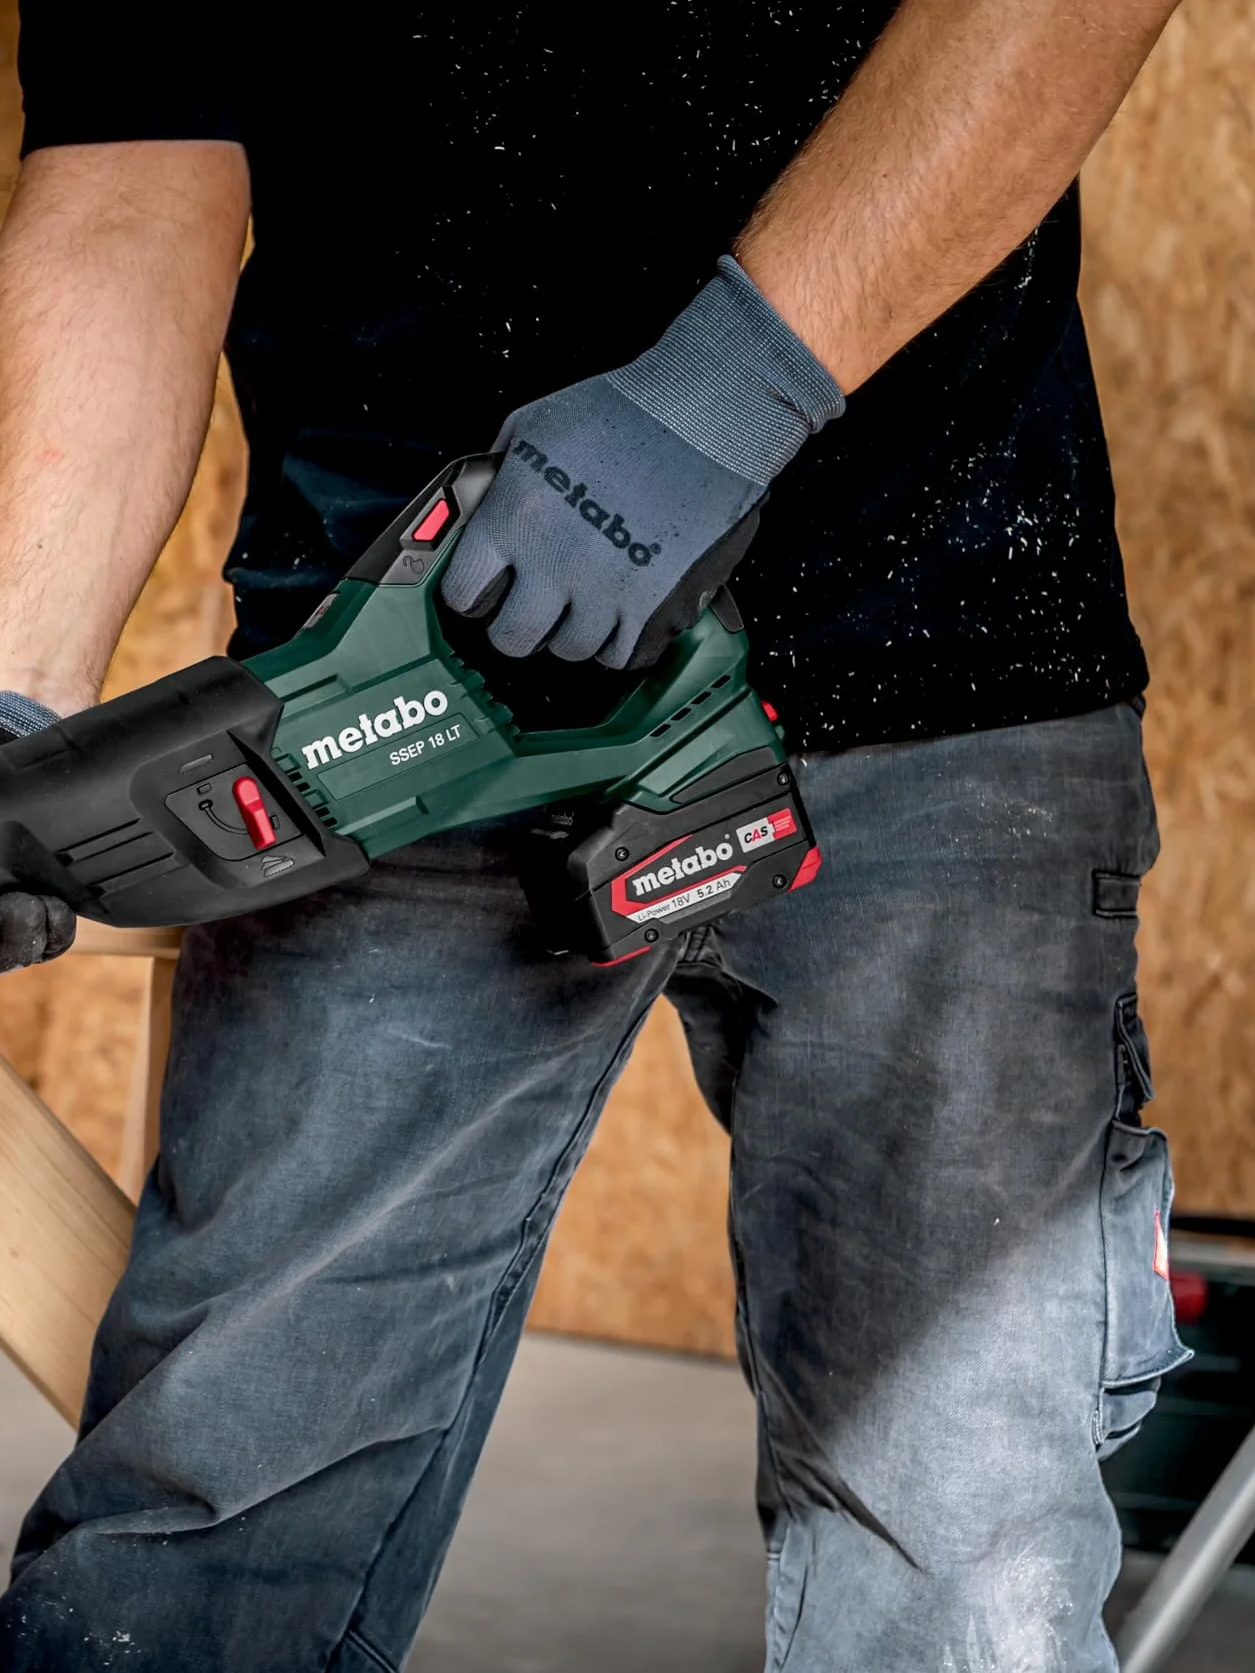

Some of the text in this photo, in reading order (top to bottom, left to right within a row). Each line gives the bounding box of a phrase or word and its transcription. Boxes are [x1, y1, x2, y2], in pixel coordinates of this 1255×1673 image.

[301, 690, 448, 769] metabo
[389, 724, 460, 765] SSEP 18 LT
[744, 826, 768, 844] CAS
[632, 842, 733, 896] metabo
[637, 879, 731, 921] Li-Power 18V 5.2 Ah
